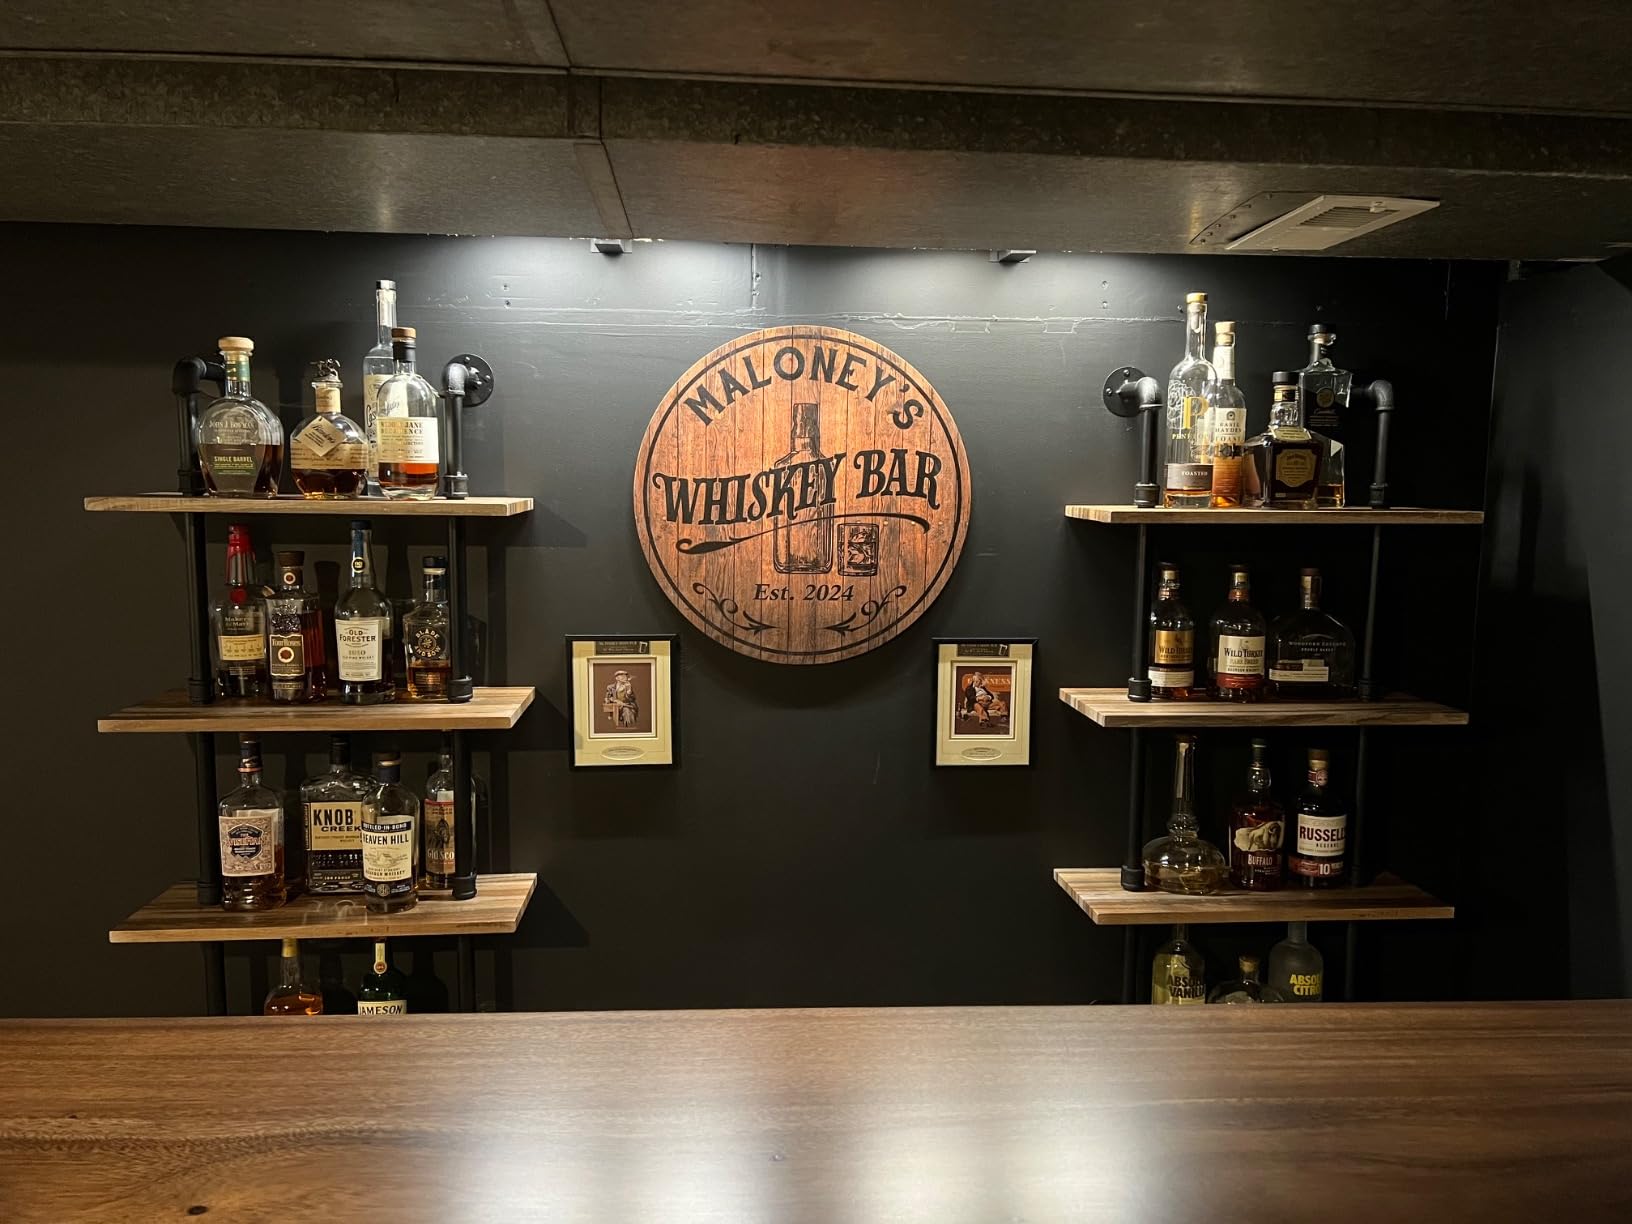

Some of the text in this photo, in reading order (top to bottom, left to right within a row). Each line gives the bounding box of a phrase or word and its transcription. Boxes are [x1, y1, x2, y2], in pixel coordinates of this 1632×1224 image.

[683, 345, 924, 430] MALONEY'S
[214, 455, 253, 463] SINGLE BARREL
[652, 448, 942, 525] WHISKEY BAR
[752, 583, 854, 601] Est. 2024
[339, 633, 376, 642] FORESTER
[415, 628, 440, 639] BLADE
[1224, 647, 1242, 657] WILD
[313, 808, 354, 827] KNOB
[390, 833, 409, 845] HILL
[1247, 853, 1273, 866] BUFFALO
[1319, 863, 1330, 875] 10
